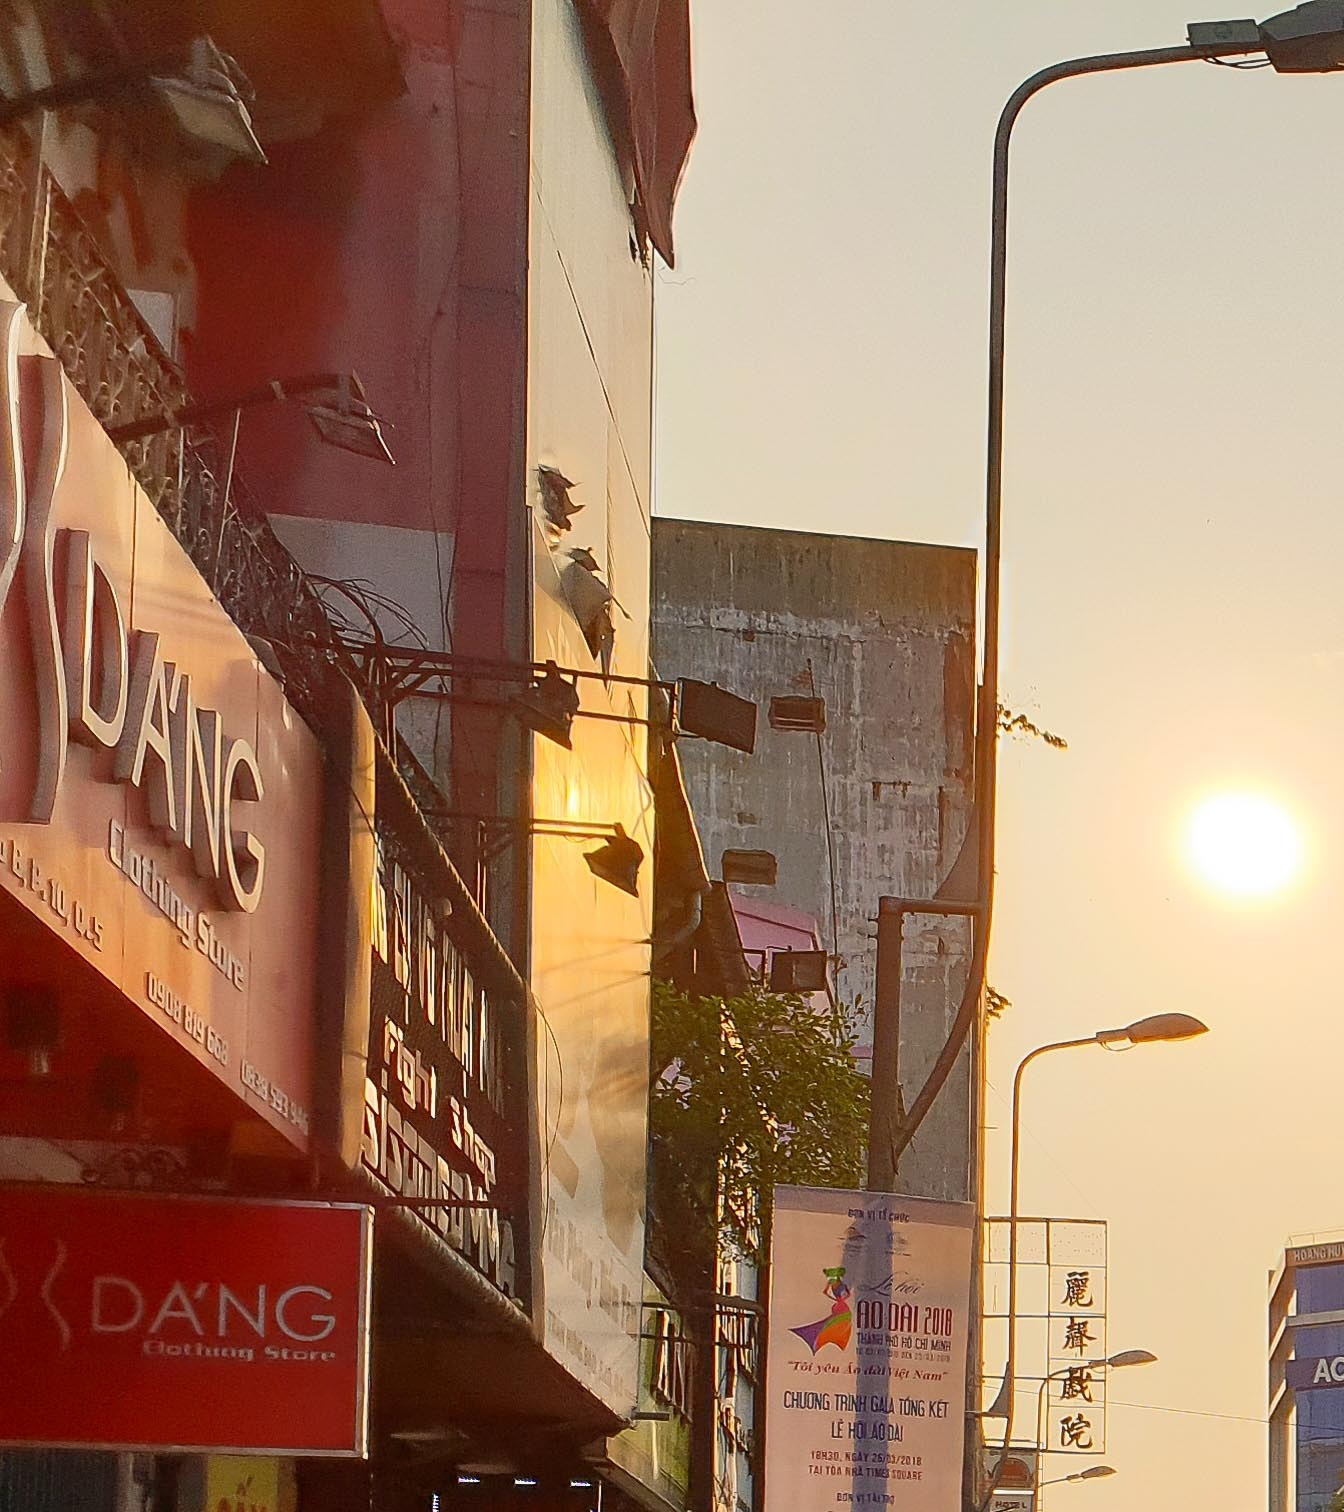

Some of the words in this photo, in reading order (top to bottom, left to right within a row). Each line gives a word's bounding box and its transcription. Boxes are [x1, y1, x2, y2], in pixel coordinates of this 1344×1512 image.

[108, 818, 194, 948] Clothing
[196, 911, 245, 991] Store
[924, 1306, 953, 1337] 2018
[142, 1340, 254, 1362] Clothing
[264, 1345, 336, 1362] Store
[931, 1339, 952, 1352] MINH
[866, 1467, 890, 1479] TIMES
[891, 1468, 923, 1481] SQUARE
[995, 1500, 1028, 1509] HOTEL
